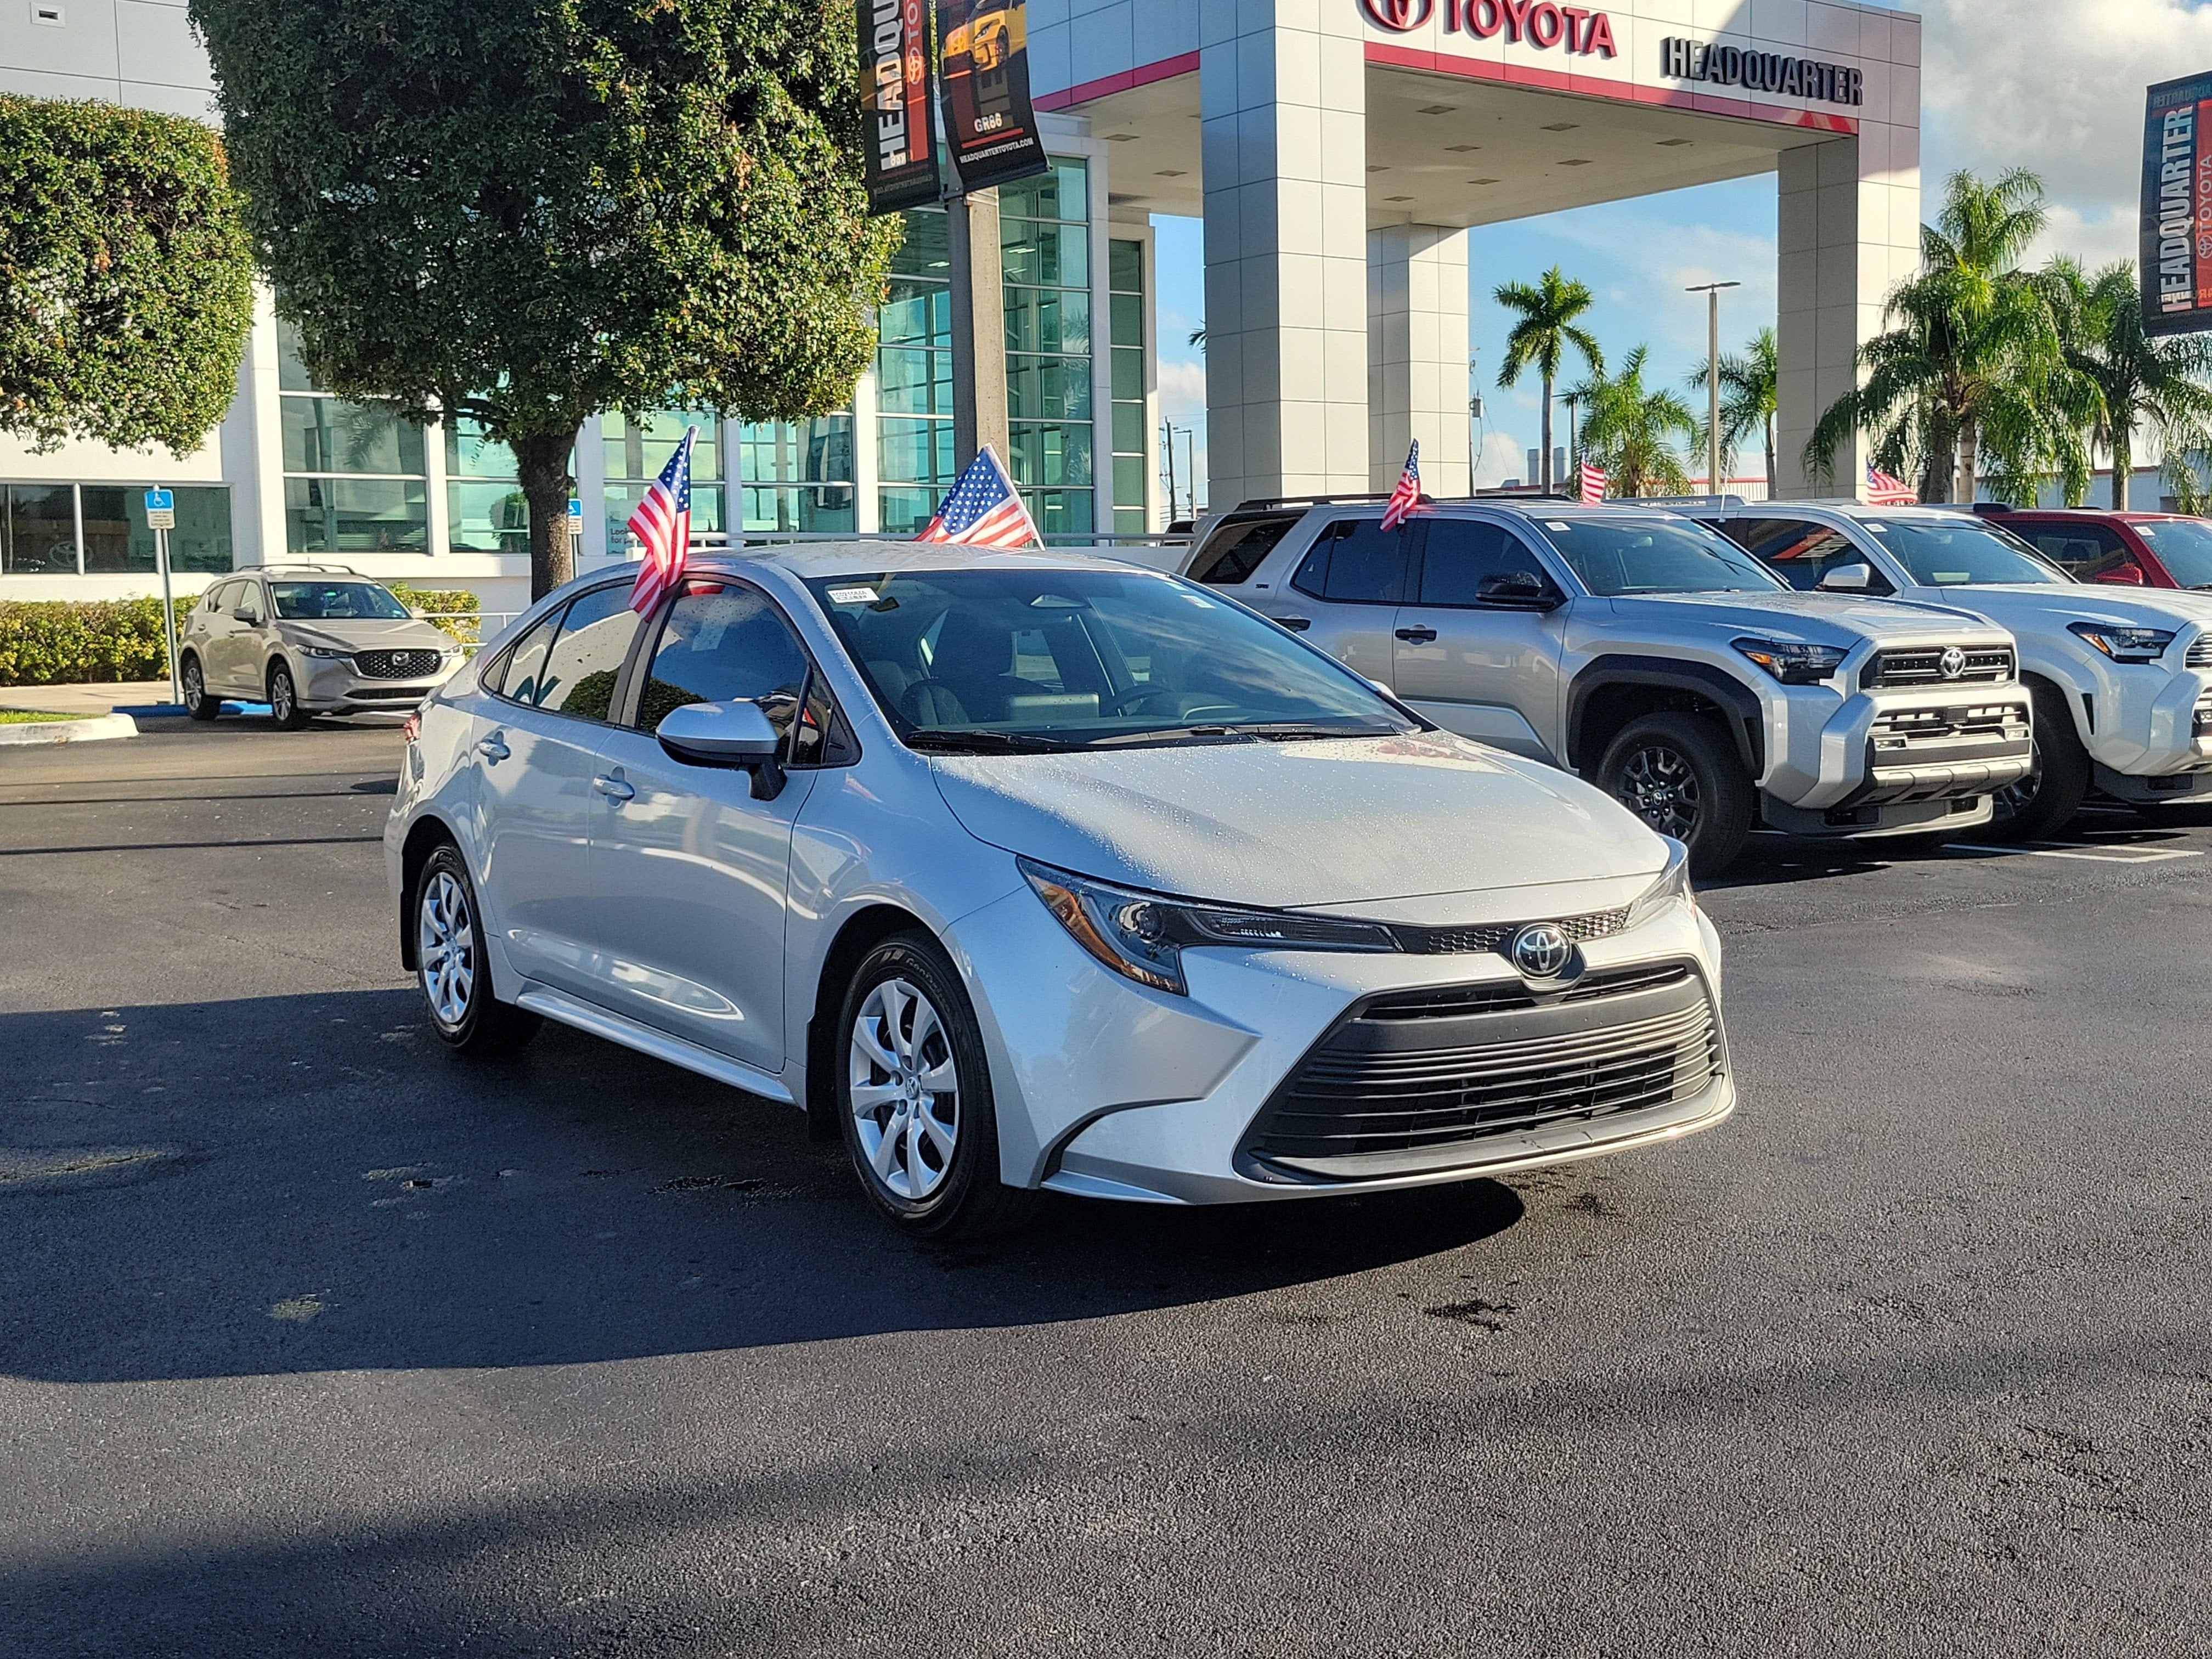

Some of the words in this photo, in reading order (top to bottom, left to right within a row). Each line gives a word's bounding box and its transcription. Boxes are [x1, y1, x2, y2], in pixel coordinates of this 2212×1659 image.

[906, 0, 919, 45] TO
[873, 0, 905, 171] HEADQU
[1660, 36, 1863, 105] HEADQUARTER
[959, 137, 1034, 163] HEADQUARTERTOYOTA.COM
[974, 112, 1002, 132] GR86
[2159, 105, 2193, 313] HEADQUARTER
[2199, 154, 2211, 234] TOYOTA
